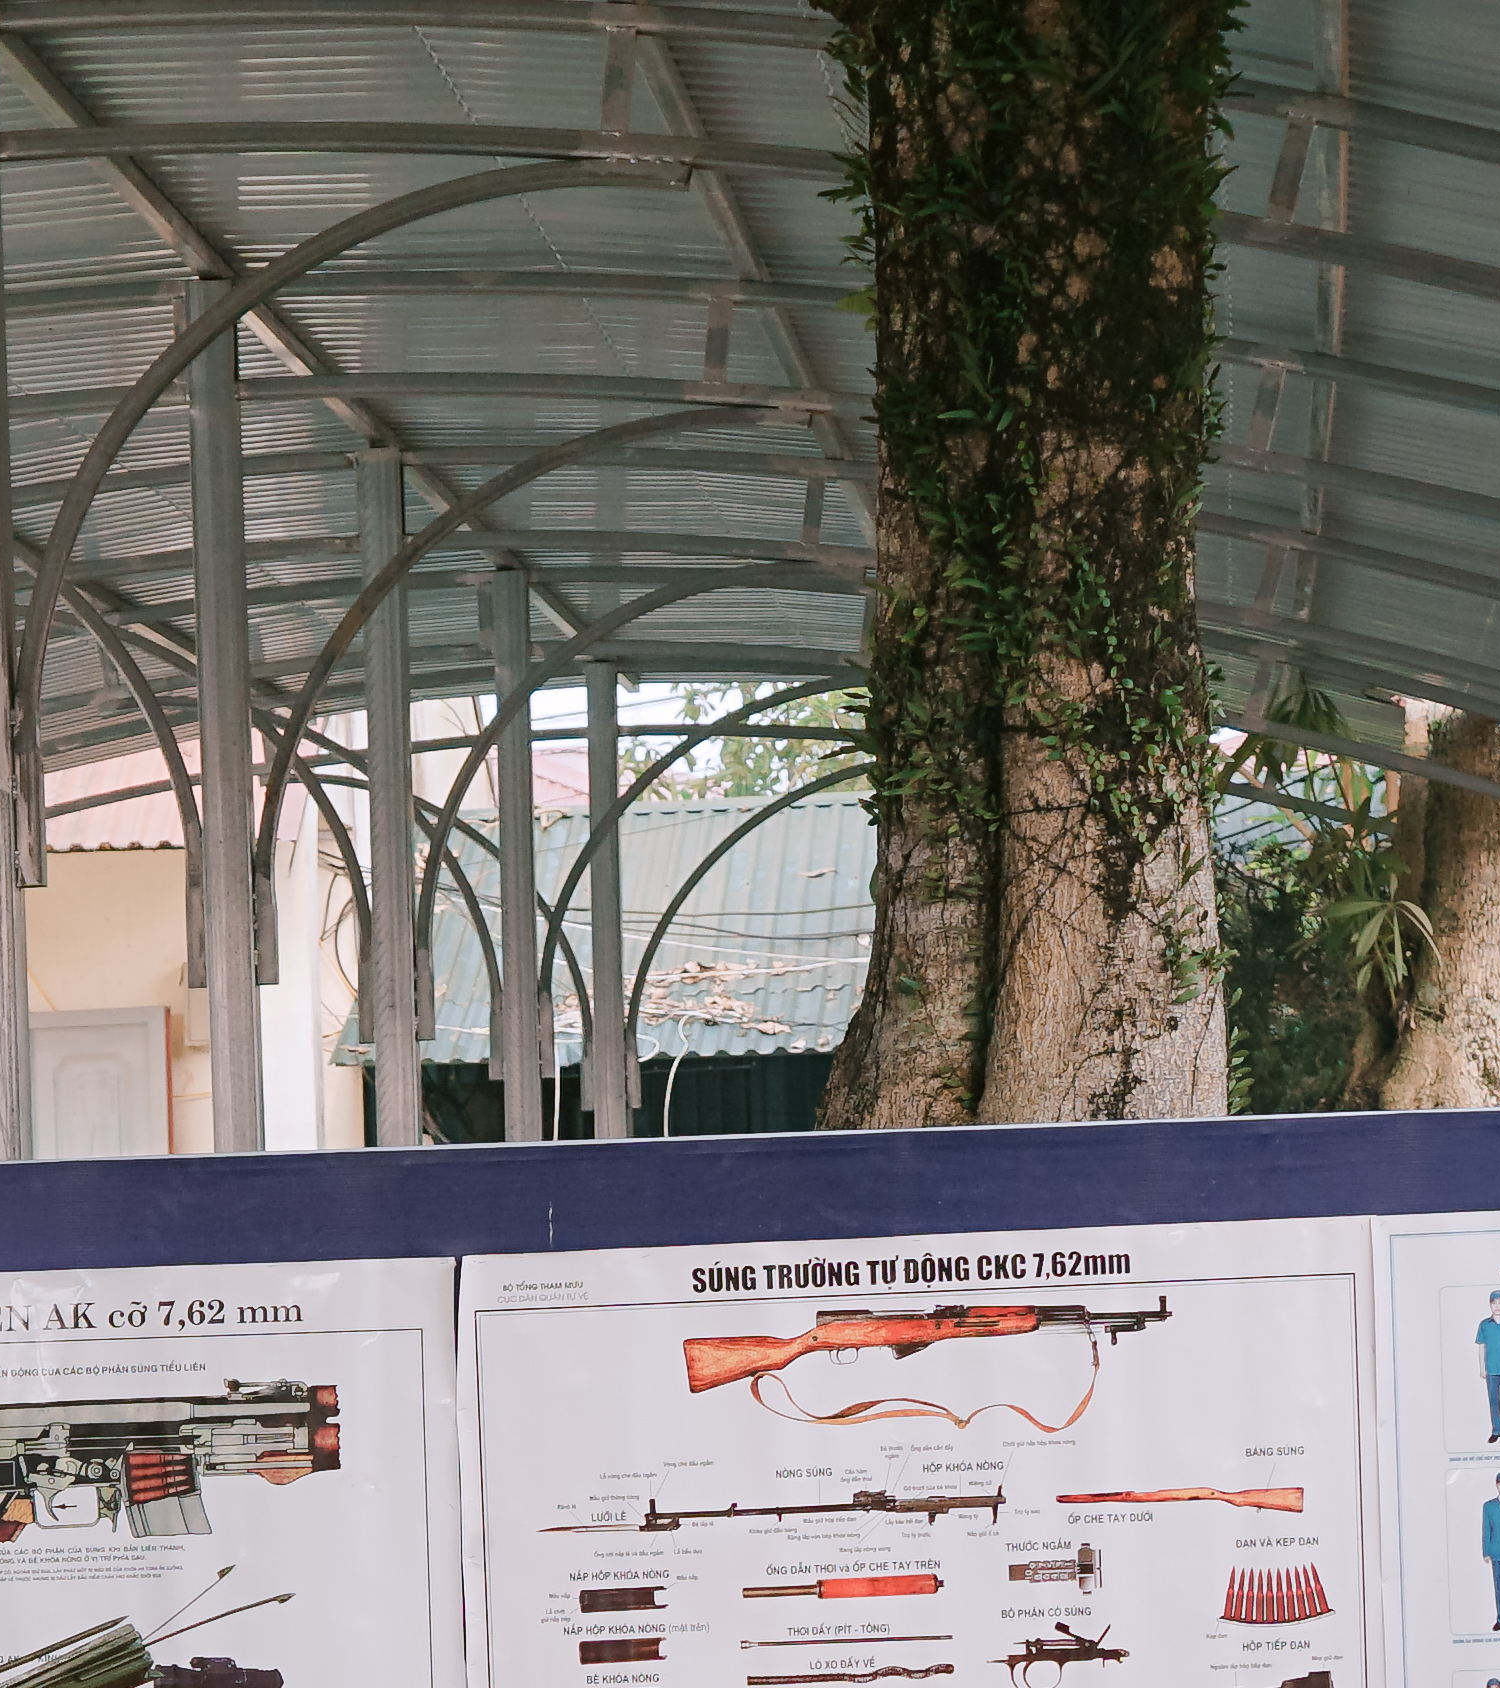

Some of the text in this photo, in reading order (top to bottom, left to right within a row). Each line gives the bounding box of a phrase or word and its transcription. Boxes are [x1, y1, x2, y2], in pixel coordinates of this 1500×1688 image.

[691, 1251, 1131, 1293] SÚNG TRƯỜNG TỰ ĐỘNG CKC 7,62mm
[42, 1302, 98, 1331] AK
[108, 1301, 148, 1329] cỡ
[157, 1299, 226, 1332] 7,62
[236, 1303, 305, 1324] mm
[1083, 1514, 1106, 1524] CHE
[1106, 1513, 1128, 1524] TAY
[868, 1561, 890, 1572] CHE
[891, 1561, 913, 1571] TAY
[824, 1660, 838, 1669] XO
